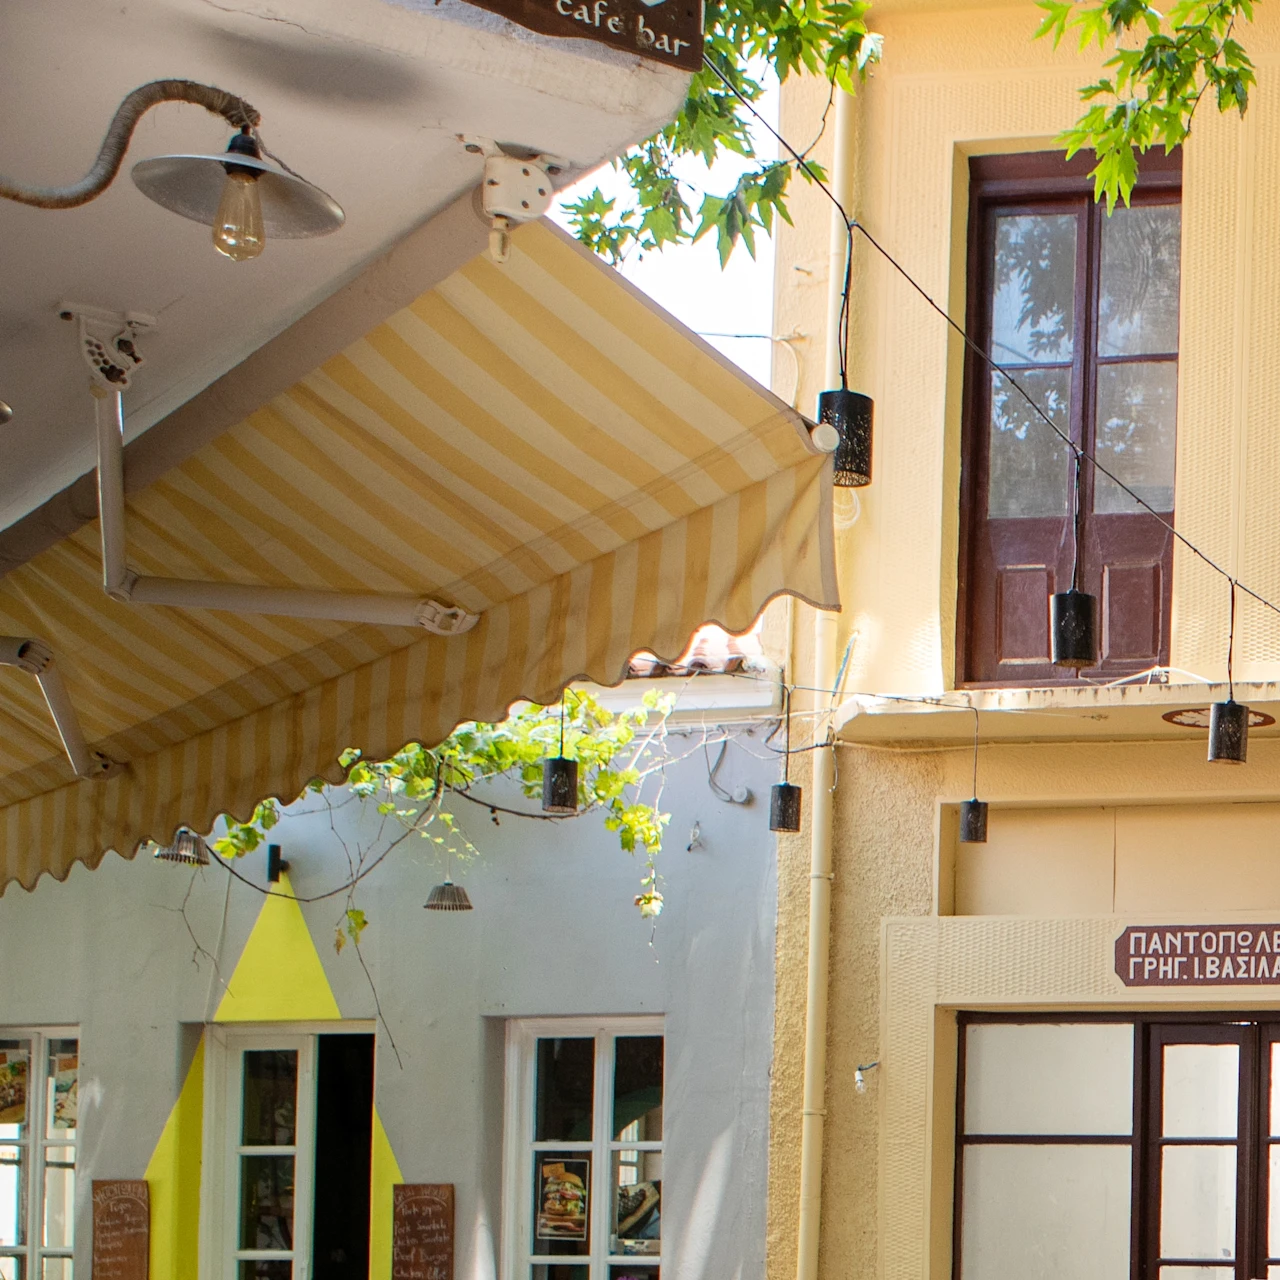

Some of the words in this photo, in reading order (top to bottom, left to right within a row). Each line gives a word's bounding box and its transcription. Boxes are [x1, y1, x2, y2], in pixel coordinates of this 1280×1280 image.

[556, 0, 622, 34] cafe
[637, 14, 691, 57] bar
[1128, 956, 1188, 980] ΓΡΗΓ.
